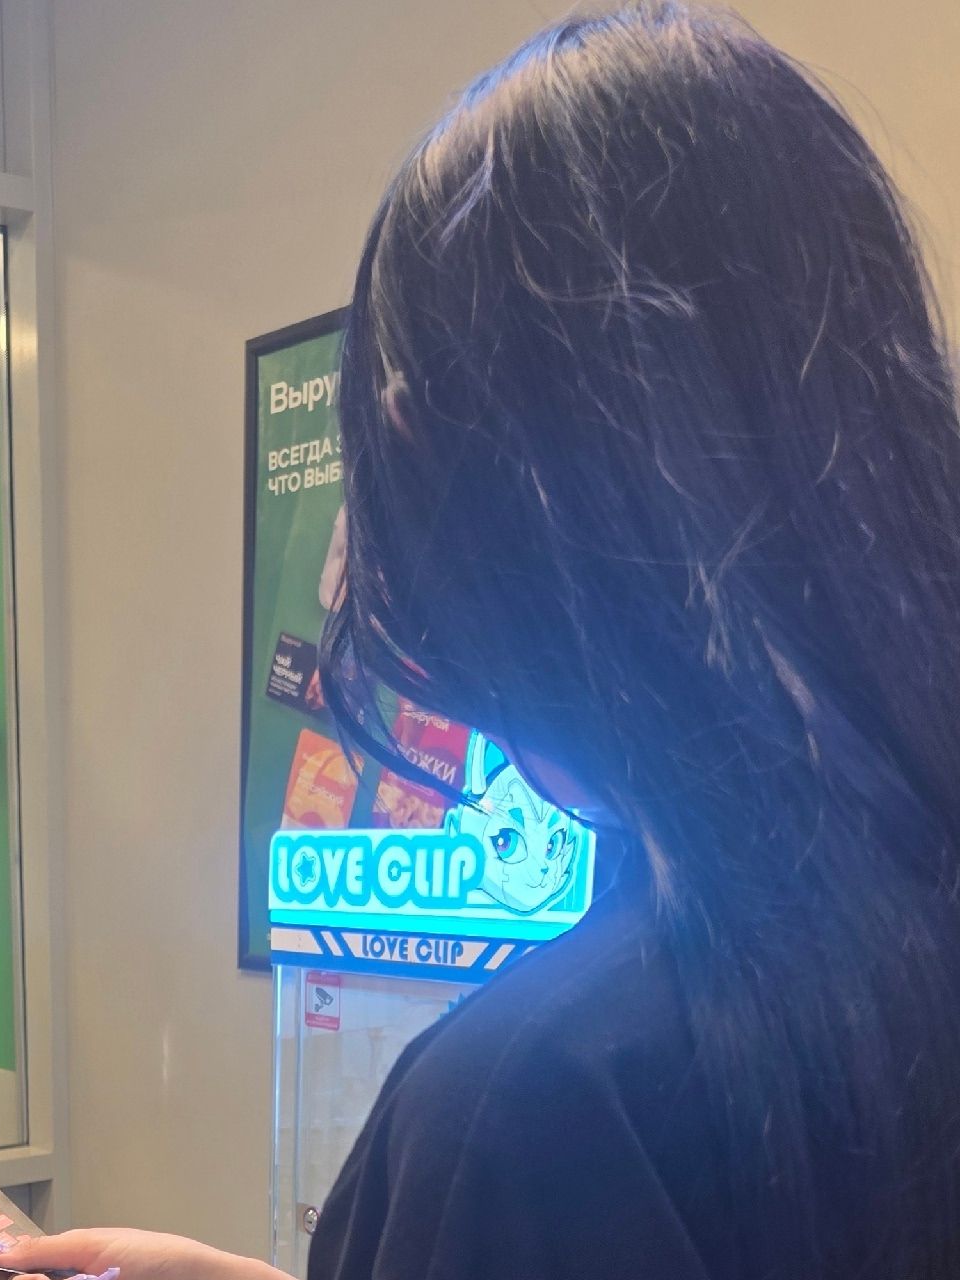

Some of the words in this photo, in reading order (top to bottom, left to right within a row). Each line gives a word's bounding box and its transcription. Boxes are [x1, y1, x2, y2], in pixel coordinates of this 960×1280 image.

[268, 437, 332, 471] ВСЕГДА
[268, 472, 300, 496] ЧТО
[277, 845, 364, 896] LOVE
[377, 845, 477, 899] CLIP
[361, 935, 408, 960] LOVE
[416, 938, 464, 965] CLIP
